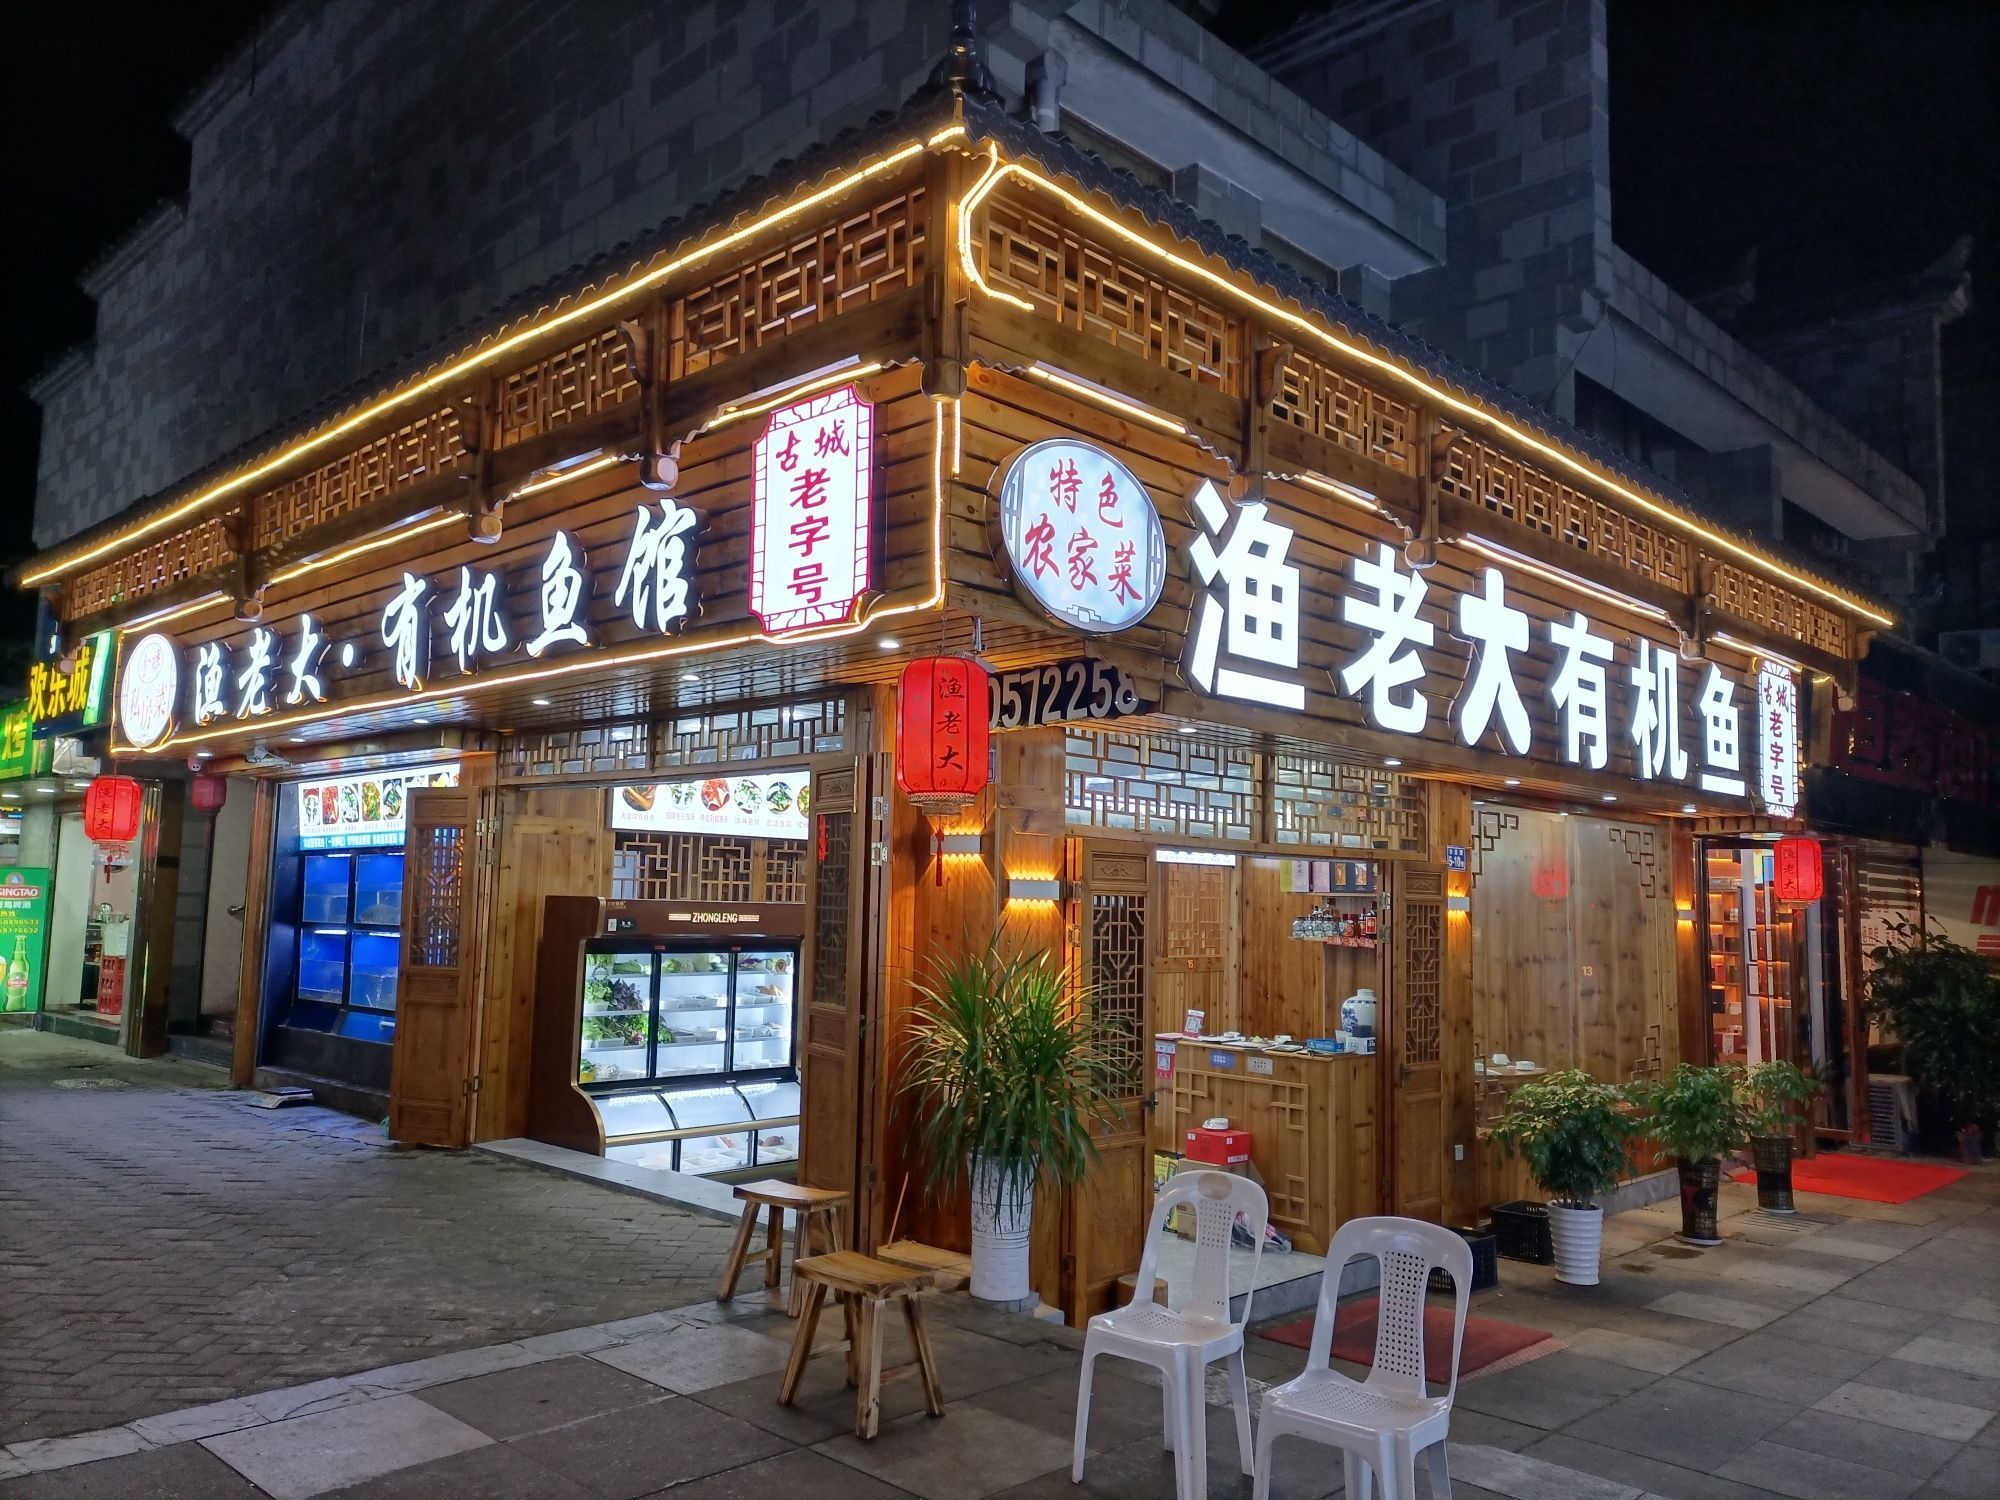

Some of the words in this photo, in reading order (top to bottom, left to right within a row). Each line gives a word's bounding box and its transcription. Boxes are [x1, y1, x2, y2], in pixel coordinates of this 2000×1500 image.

[775, 418, 850, 473] 古城
[1049, 458, 1124, 528] 特色
[787, 467, 831, 604] 老字号
[1022, 512, 1143, 606] 农家菜
[1189, 478, 1746, 797] 渔老大有机鱼
[27, 645, 90, 723] 欢乐城
[1763, 676, 1789, 713] 古城
[936, 676, 966, 770] 渔老大
[1769, 708, 1785, 803] 老字号
[1782, 847, 1797, 891] 渔老大
[691, 912, 738, 924] ZHONGLENG
[1581, 965, 1593, 977] 13
